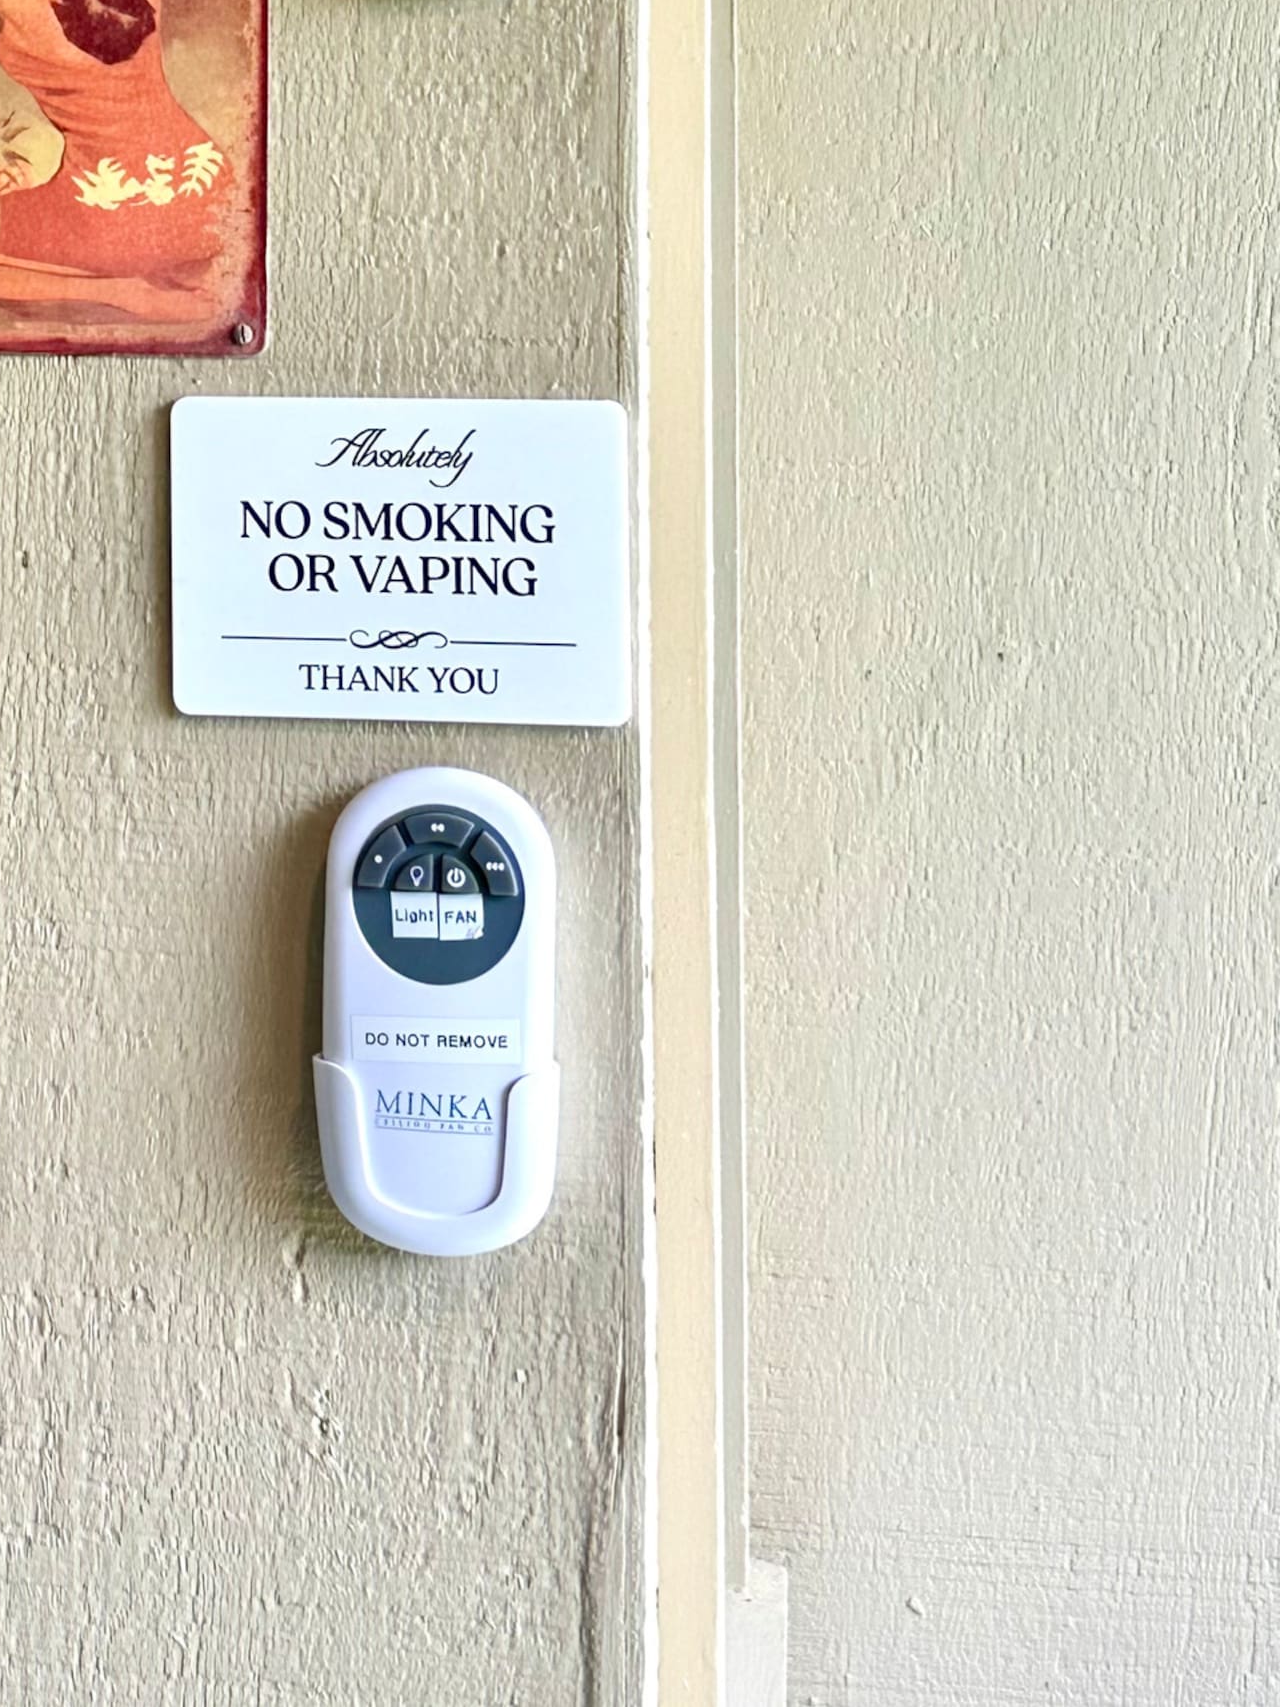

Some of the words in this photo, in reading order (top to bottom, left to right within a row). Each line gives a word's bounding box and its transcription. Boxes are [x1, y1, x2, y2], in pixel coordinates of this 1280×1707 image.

[315, 427, 477, 488] Absolutely
[240, 500, 311, 539] NO
[322, 501, 556, 544] SMOKING
[268, 553, 338, 592] OR
[349, 555, 538, 597] VAPING
[299, 663, 420, 693] THANK
[426, 667, 500, 695] YOU
[395, 908, 434, 923] Light
[445, 910, 477, 924] FAN
[365, 1032, 389, 1046] DO
[396, 1034, 430, 1048] NOT
[437, 1035, 508, 1048] REMOVE
[375, 1089, 492, 1120] MINKA
